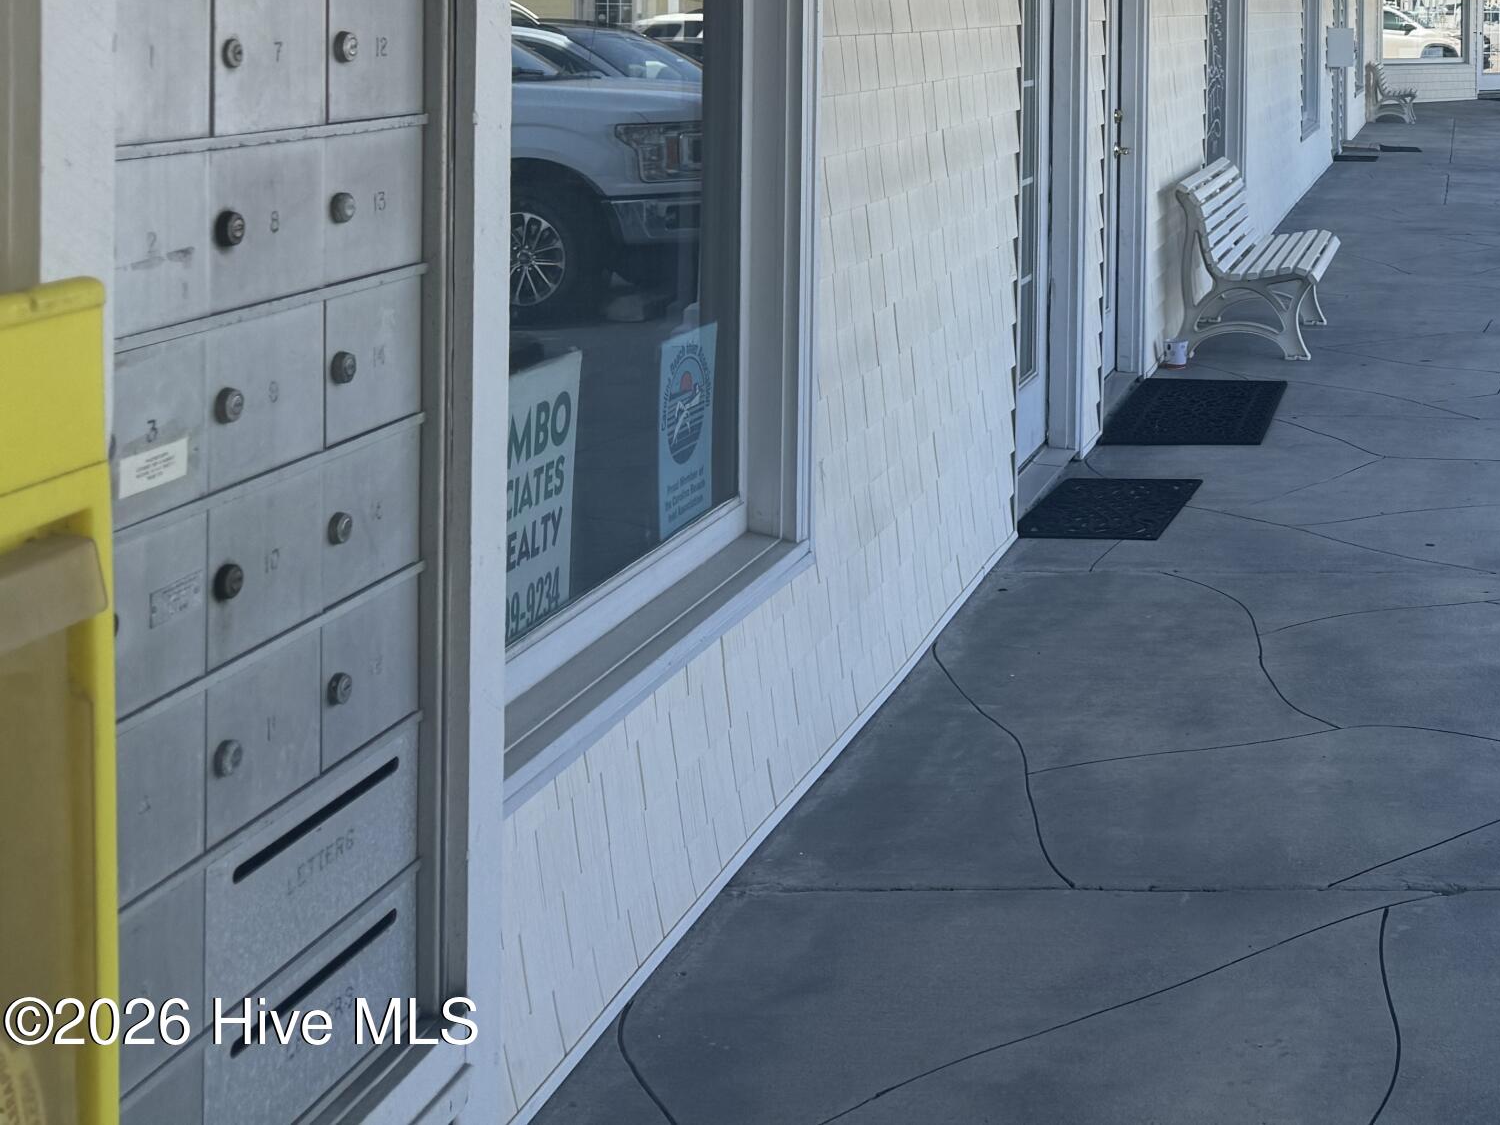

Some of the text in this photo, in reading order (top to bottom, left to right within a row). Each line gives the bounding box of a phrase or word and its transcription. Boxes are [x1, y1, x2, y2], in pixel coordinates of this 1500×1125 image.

[273, 42, 284, 63] 7
[376, 37, 389, 57] 12
[373, 191, 387, 213] 13
[269, 211, 280, 233] 8
[146, 419, 158, 443] 3
